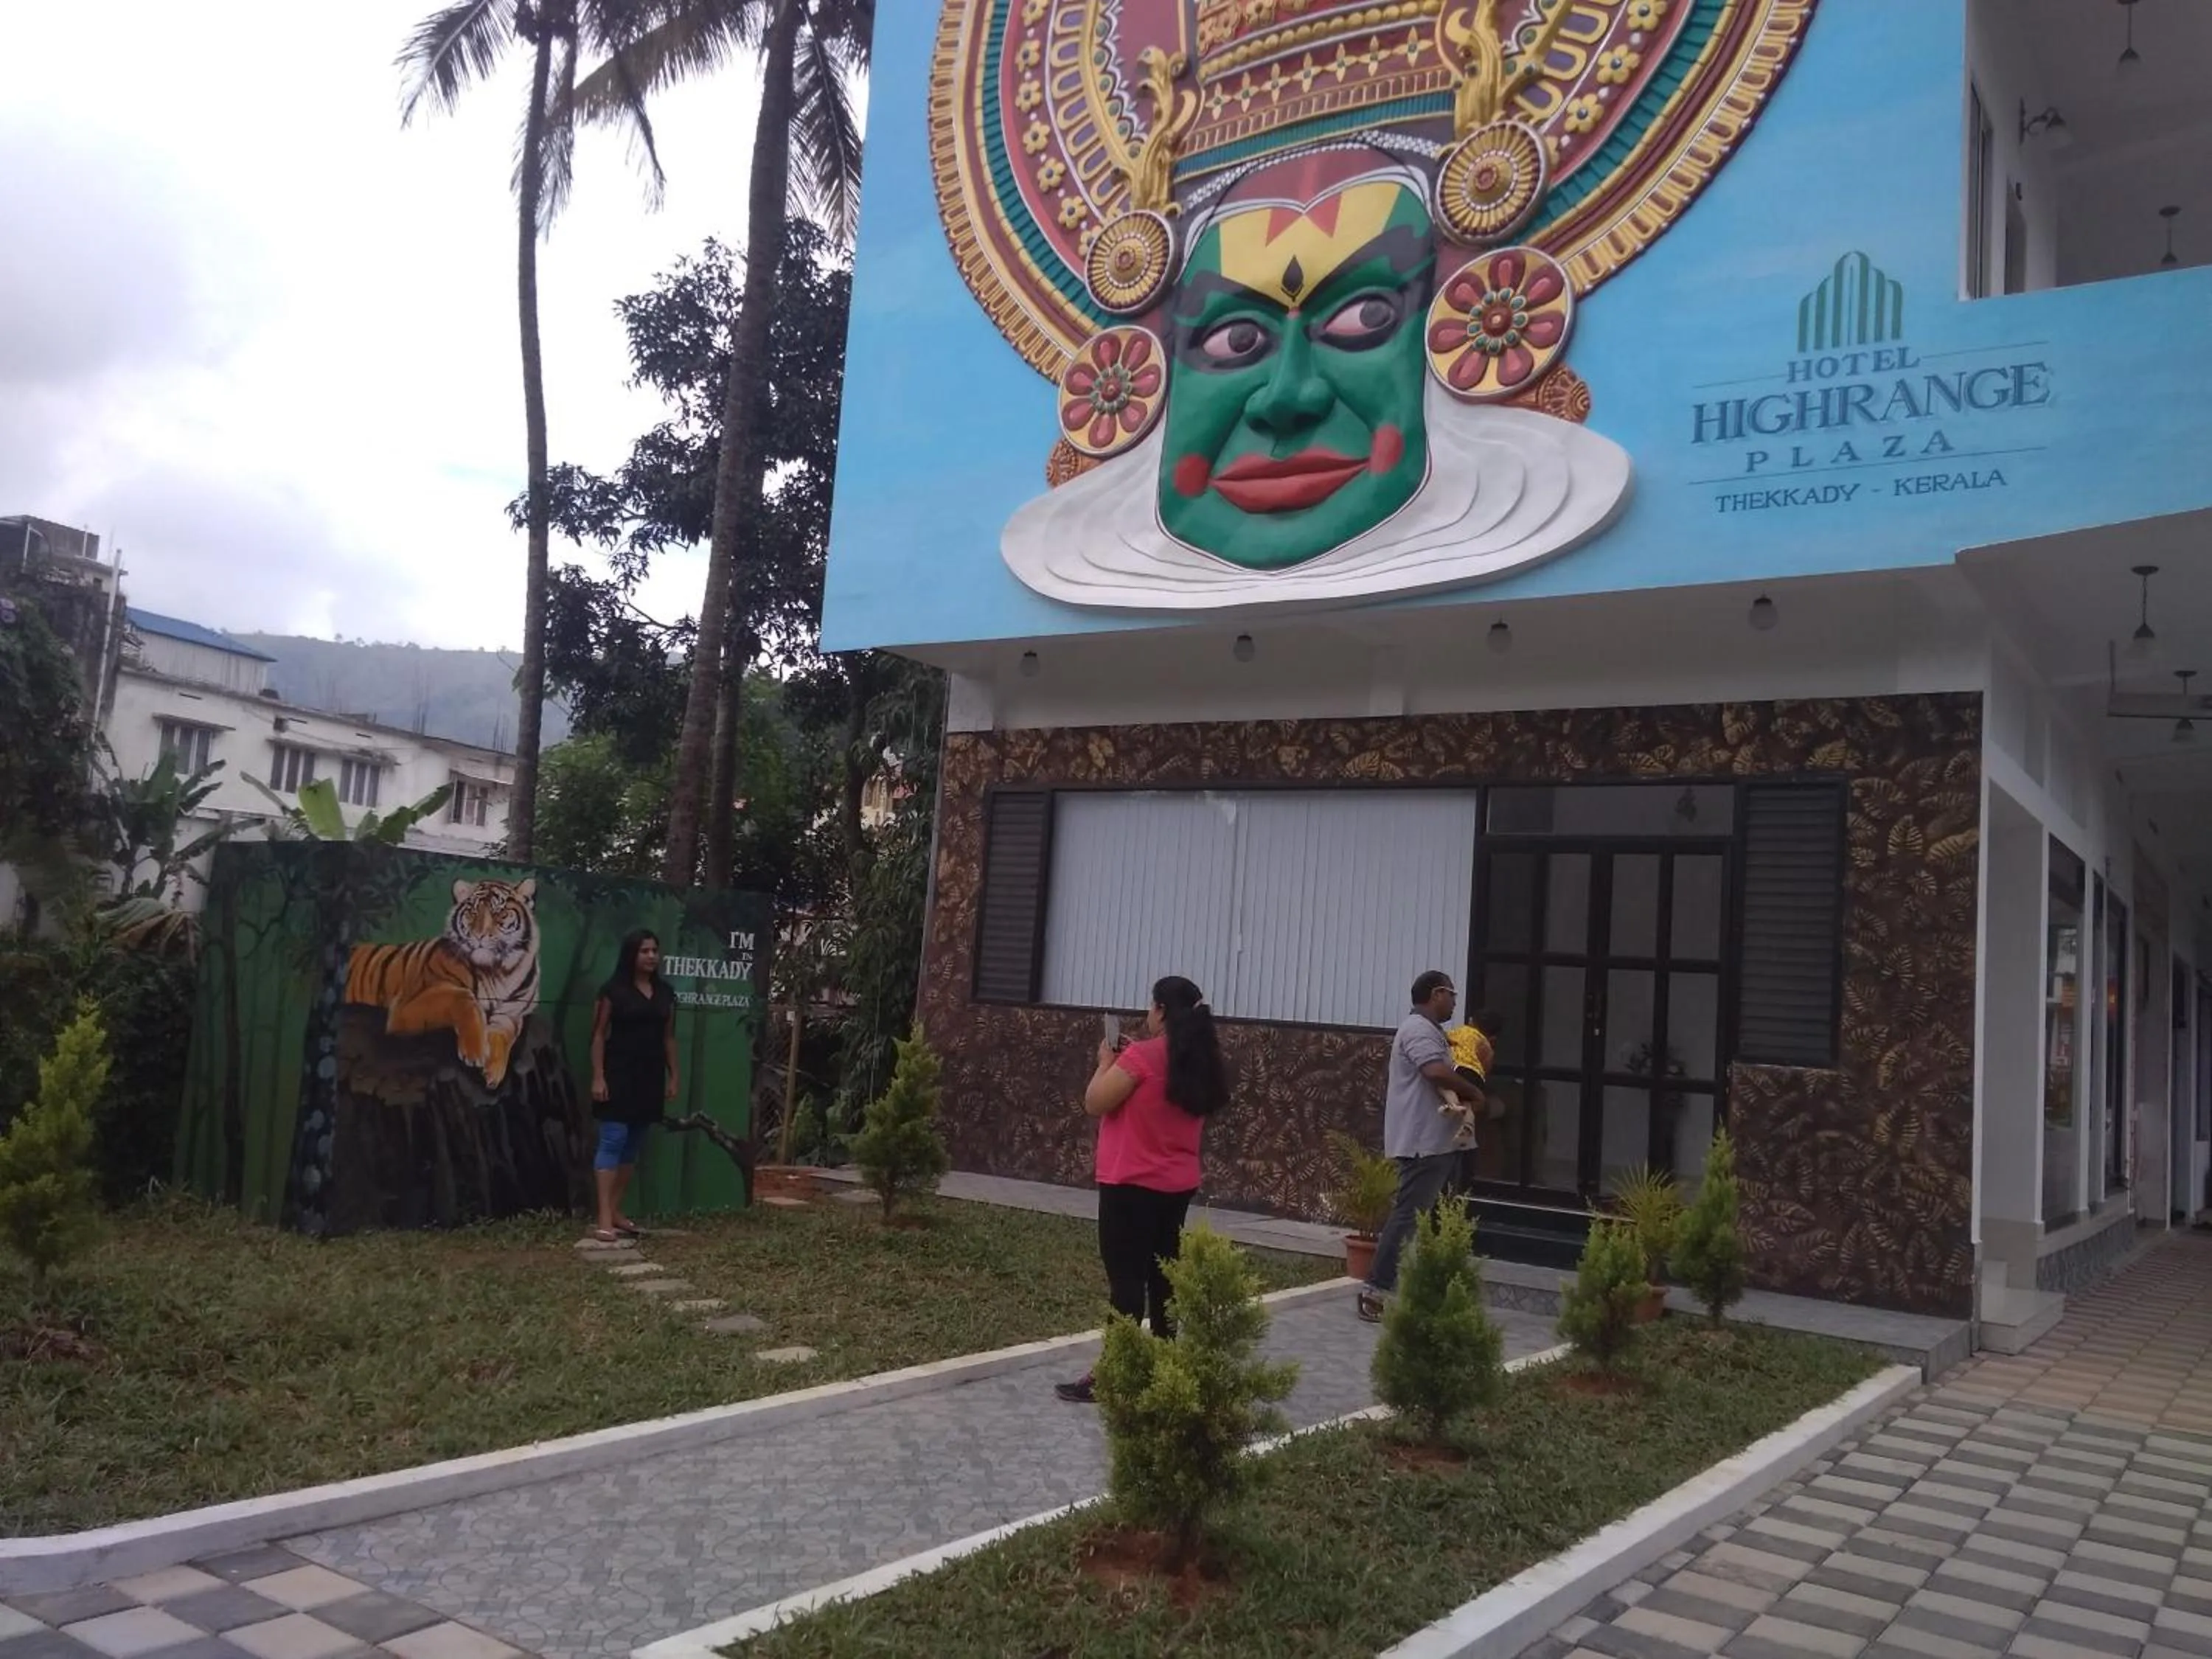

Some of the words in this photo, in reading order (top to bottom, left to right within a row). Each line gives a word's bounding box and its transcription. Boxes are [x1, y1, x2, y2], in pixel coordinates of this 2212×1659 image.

[1786, 346, 1920, 383] HOTEL
[1691, 361, 2050, 444] HIGHRANGE
[1745, 430, 1955, 473] PLAZA
[1715, 482, 1861, 512] THEKKADY
[1893, 469, 2007, 497] KERALA
[664, 956, 753, 981] THEKKADY
